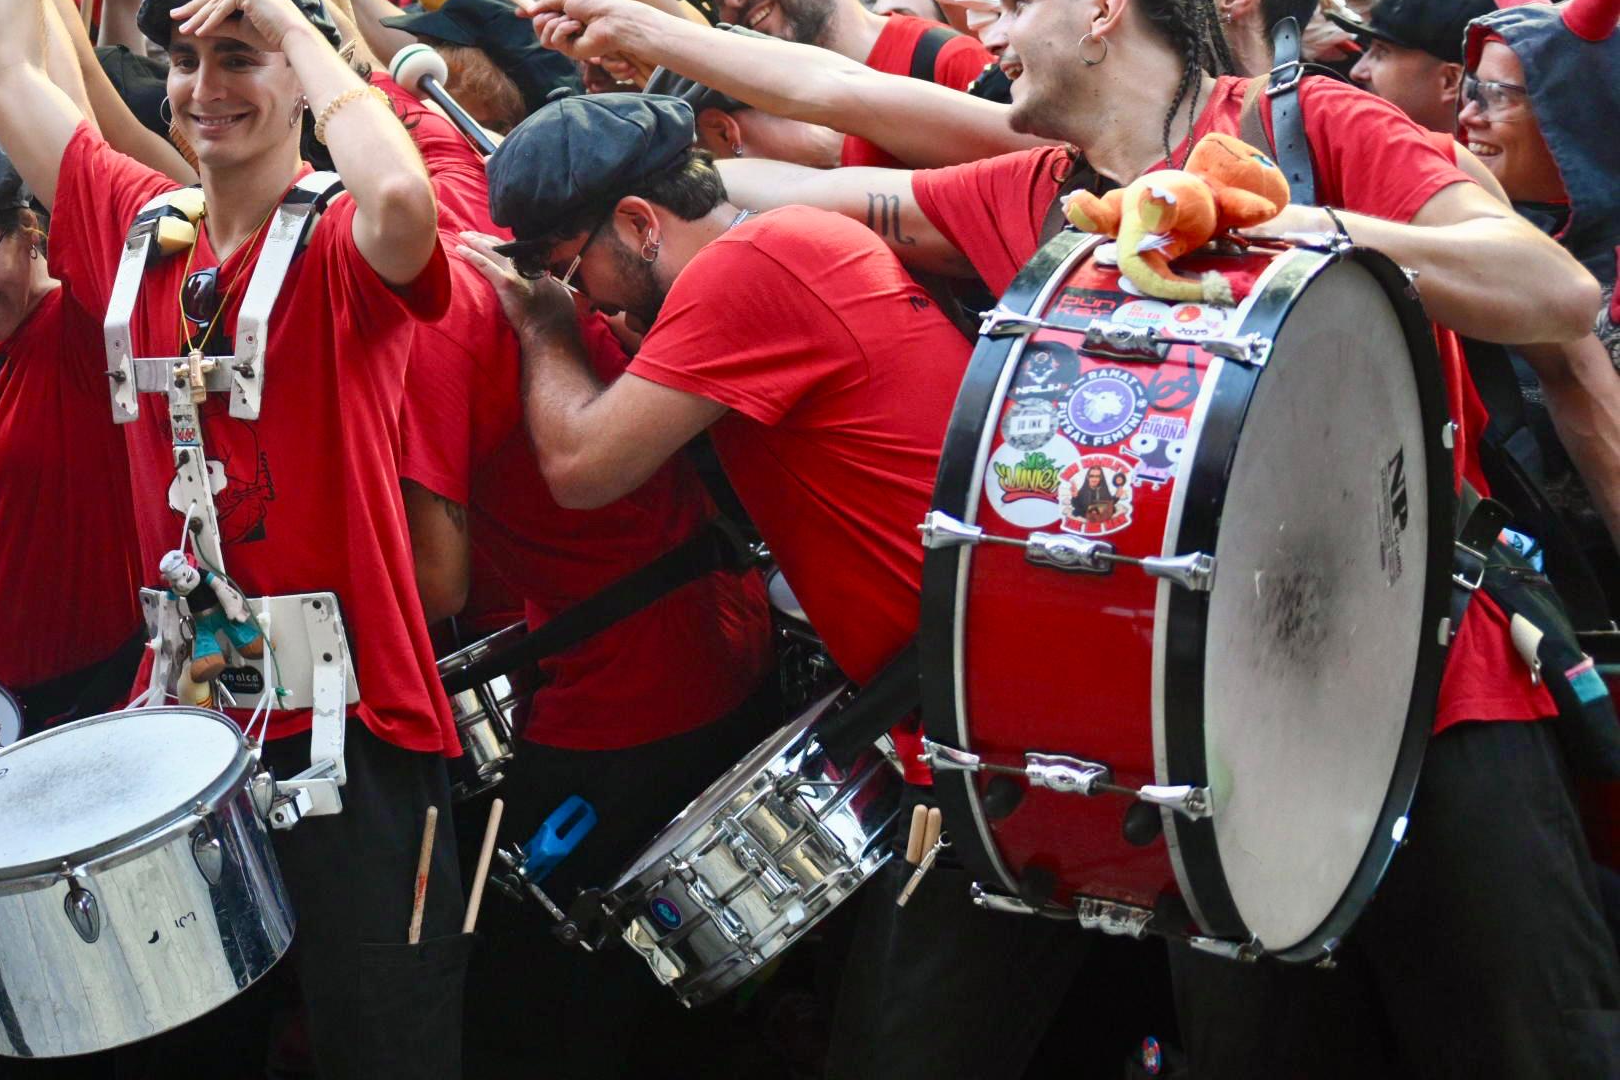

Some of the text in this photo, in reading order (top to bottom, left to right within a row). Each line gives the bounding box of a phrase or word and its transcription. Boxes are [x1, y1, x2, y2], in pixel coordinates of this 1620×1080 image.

[1088, 368, 1138, 385] RAMAT
[1057, 401, 1088, 446] FUTSAL
[1141, 421, 1186, 440] GIRONA
